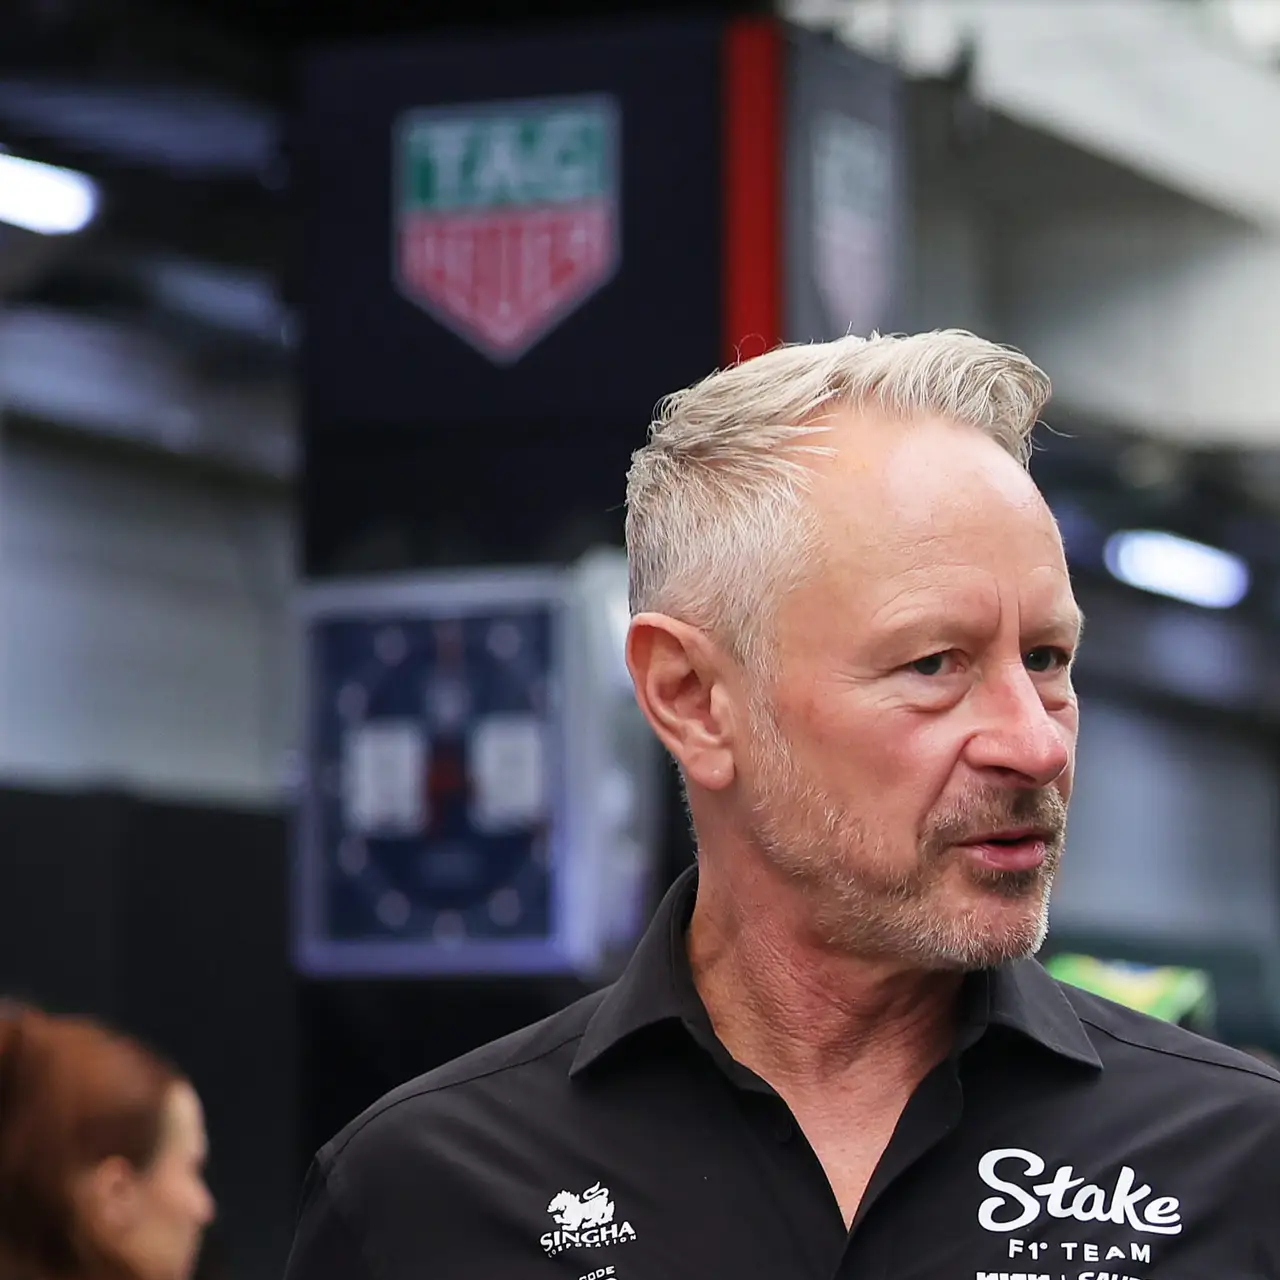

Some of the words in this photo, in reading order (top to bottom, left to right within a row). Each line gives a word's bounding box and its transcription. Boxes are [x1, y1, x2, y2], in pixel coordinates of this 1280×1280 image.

[410, 112, 604, 208] TAG
[978, 1148, 1182, 1234] Stake
[540, 1221, 635, 1252] SINGHA
[1061, 1242, 1150, 1263] TEAM
